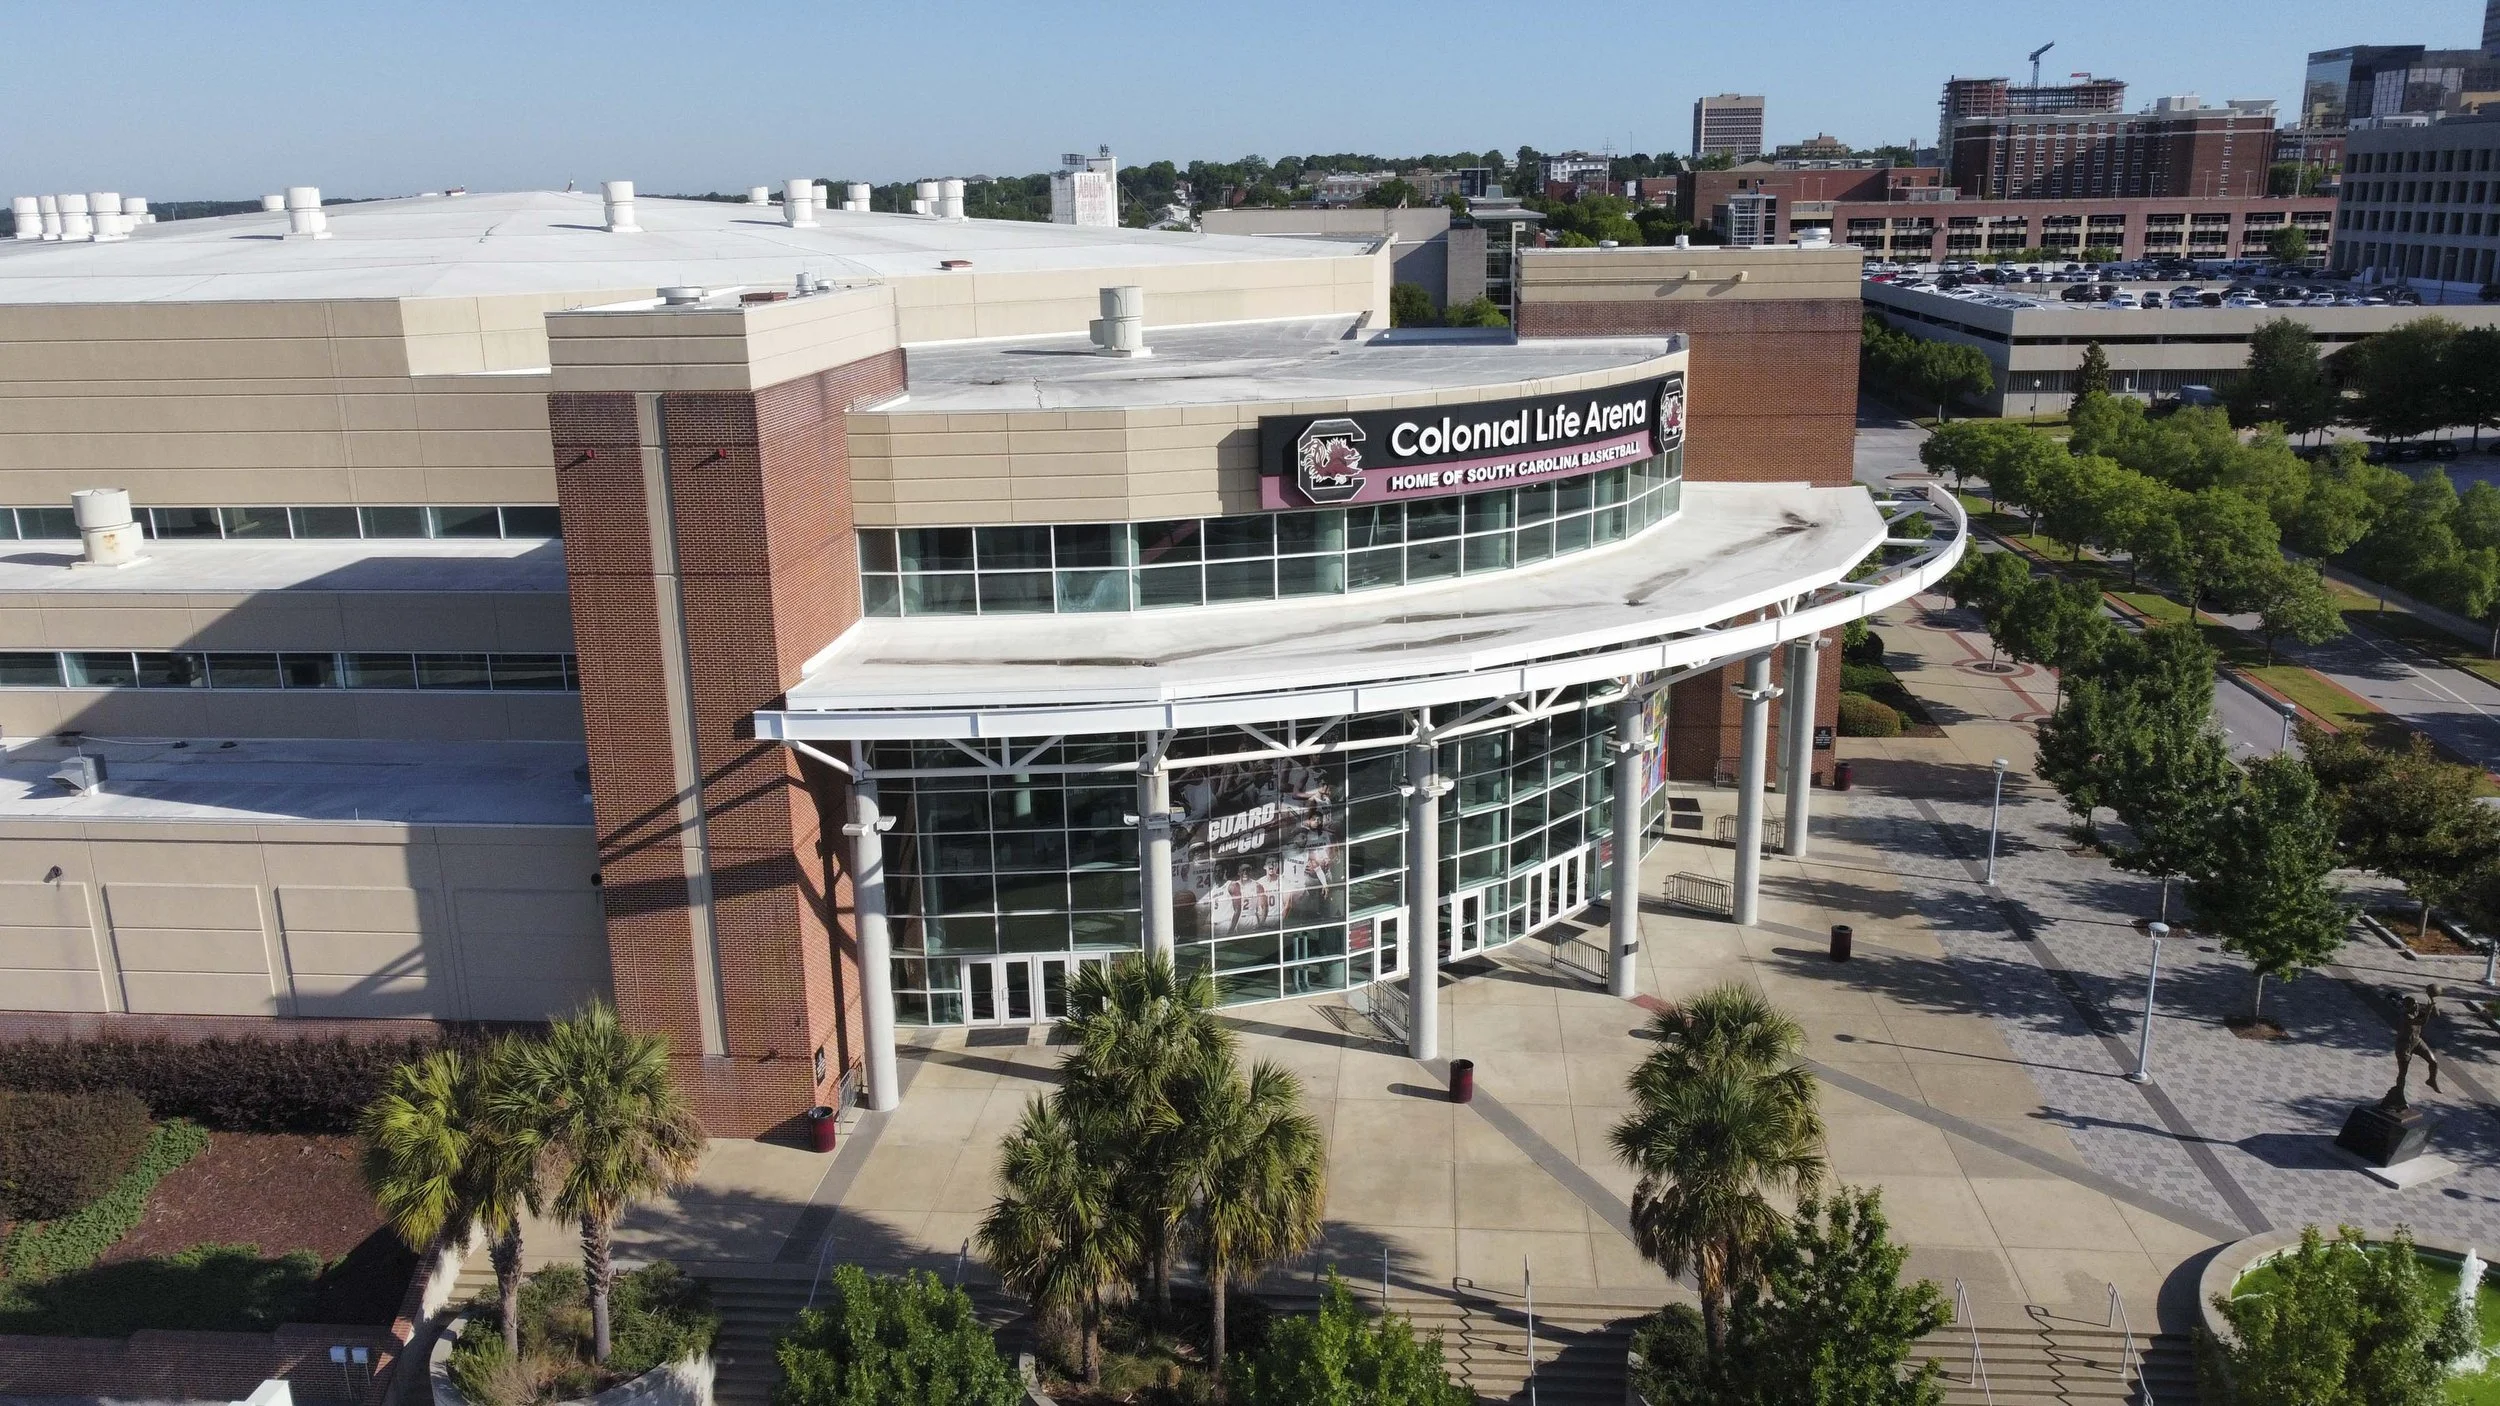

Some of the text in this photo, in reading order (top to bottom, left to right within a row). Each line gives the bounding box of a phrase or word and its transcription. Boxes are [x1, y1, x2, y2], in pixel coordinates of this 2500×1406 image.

[1391, 399, 1647, 457] Colonial Life Arena
[1391, 440, 1641, 491] HOME OF SOUTH CAROLINA BASKETBALL
[1207, 802, 1276, 843] GUARD
[1217, 827, 1266, 854] AND GO
